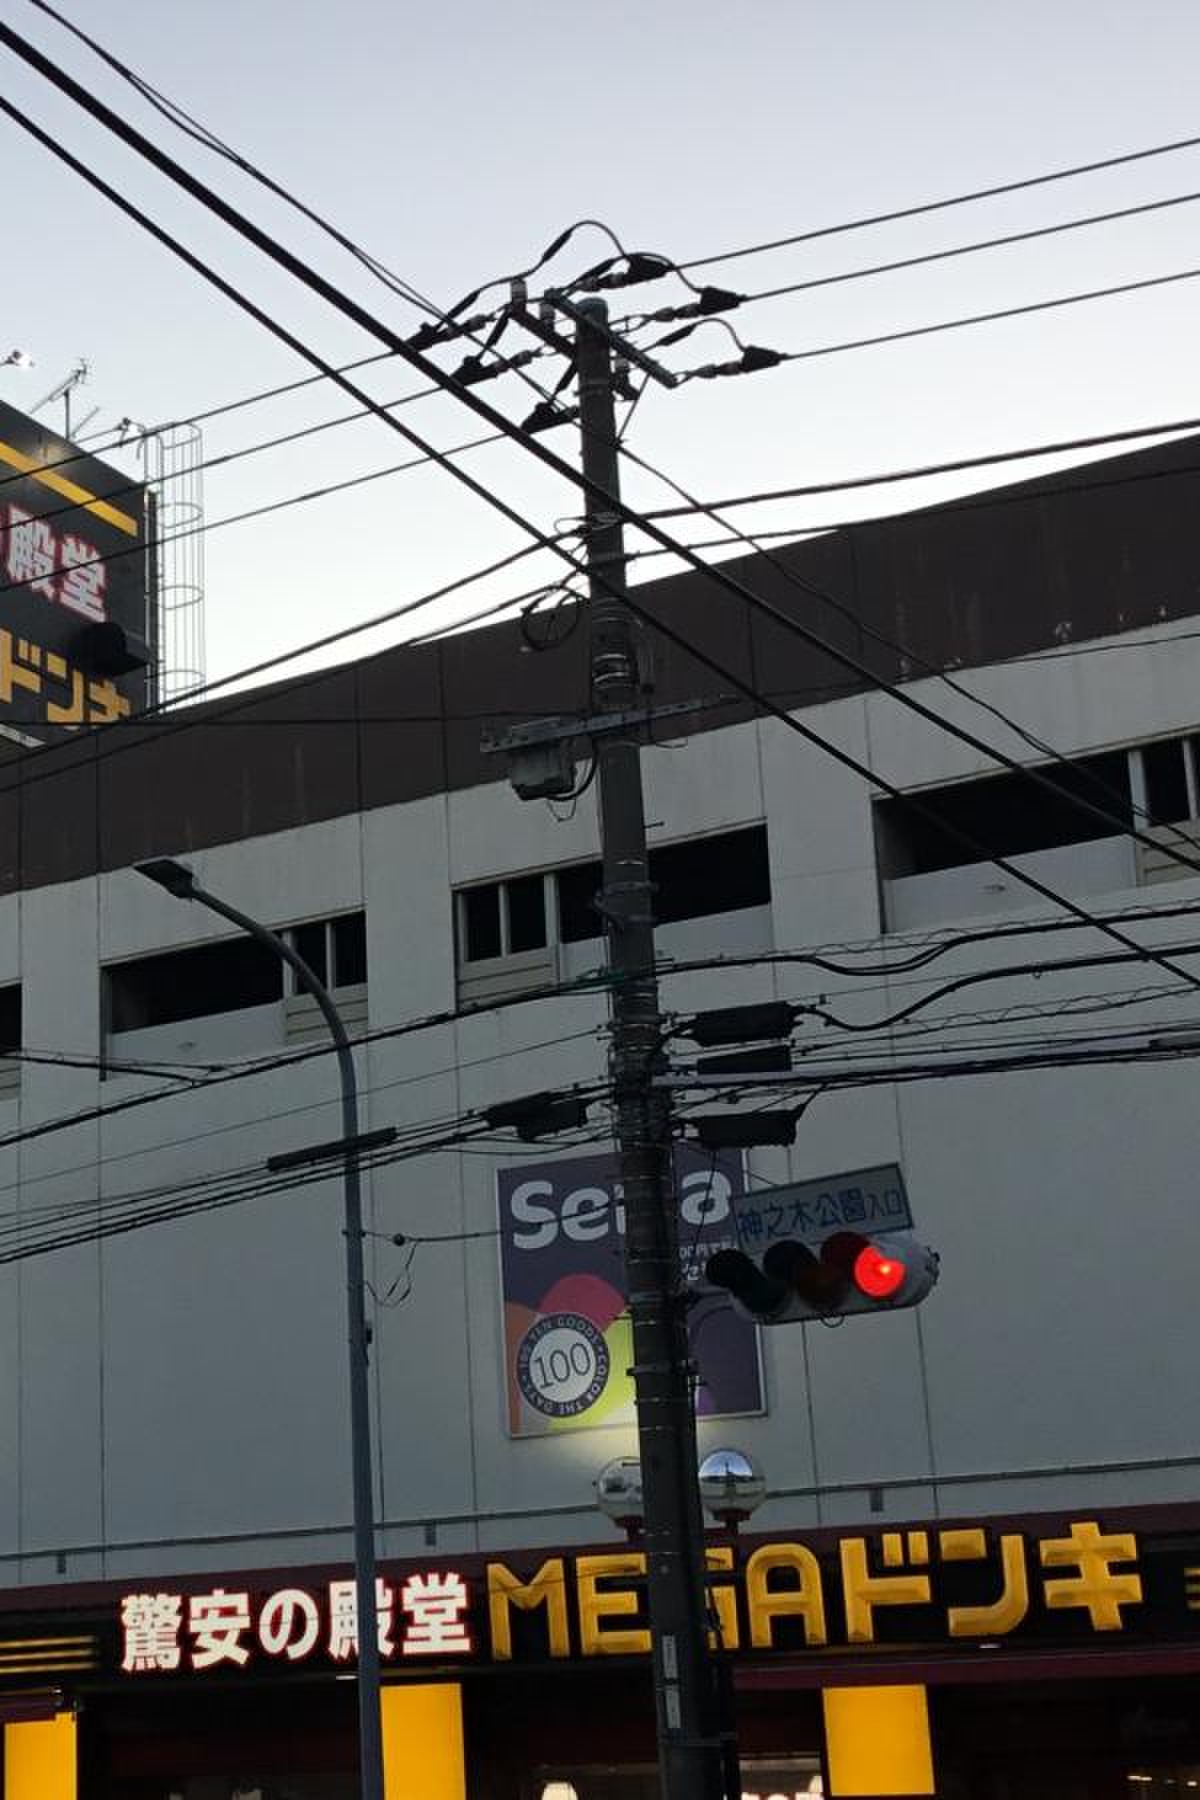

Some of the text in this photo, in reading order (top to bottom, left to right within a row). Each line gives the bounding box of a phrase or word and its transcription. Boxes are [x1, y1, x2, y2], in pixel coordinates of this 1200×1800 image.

[510, 1169, 732, 1250] Sea
[534, 1343, 591, 1389] 100
[119, 1571, 472, 1673] 驚安の殿堂
